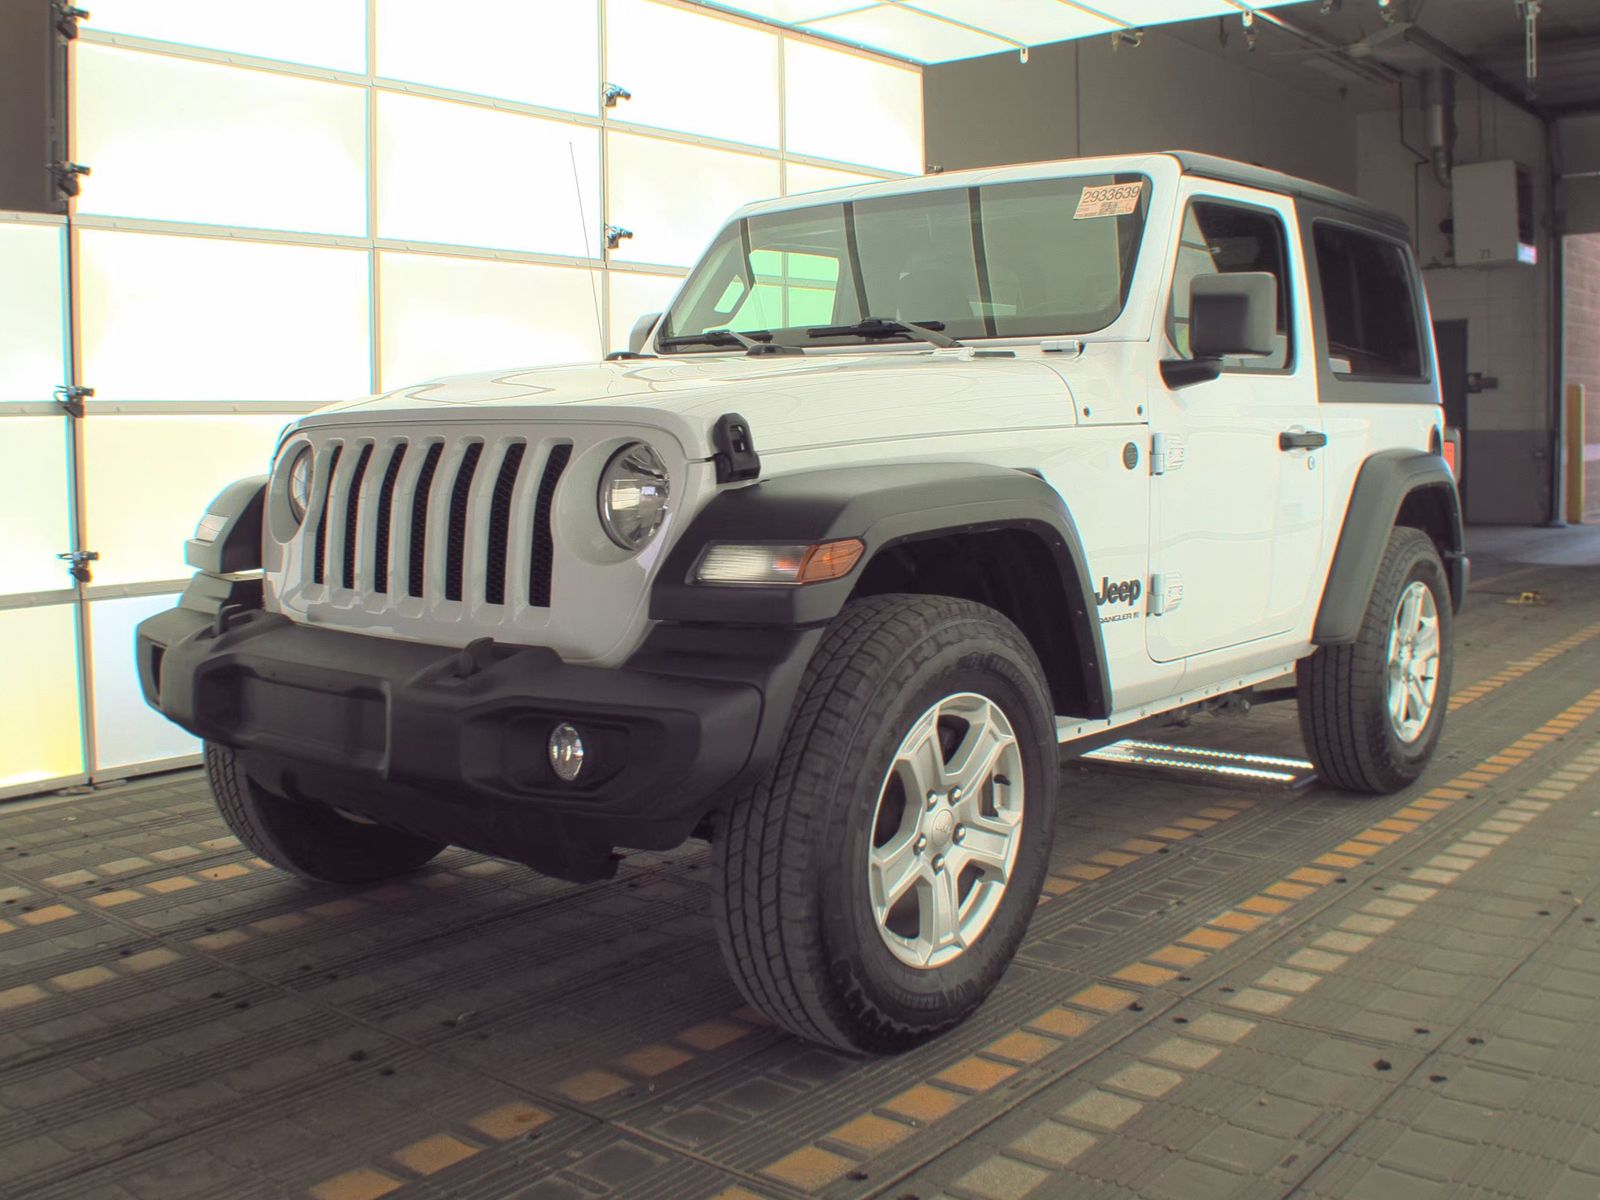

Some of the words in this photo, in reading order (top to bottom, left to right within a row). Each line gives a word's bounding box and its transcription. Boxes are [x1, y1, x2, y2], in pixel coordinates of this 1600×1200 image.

[1082, 185, 1140, 203] 2933639
[1094, 576, 1141, 606] Jeep
[1098, 612, 1132, 624] RANGLER
